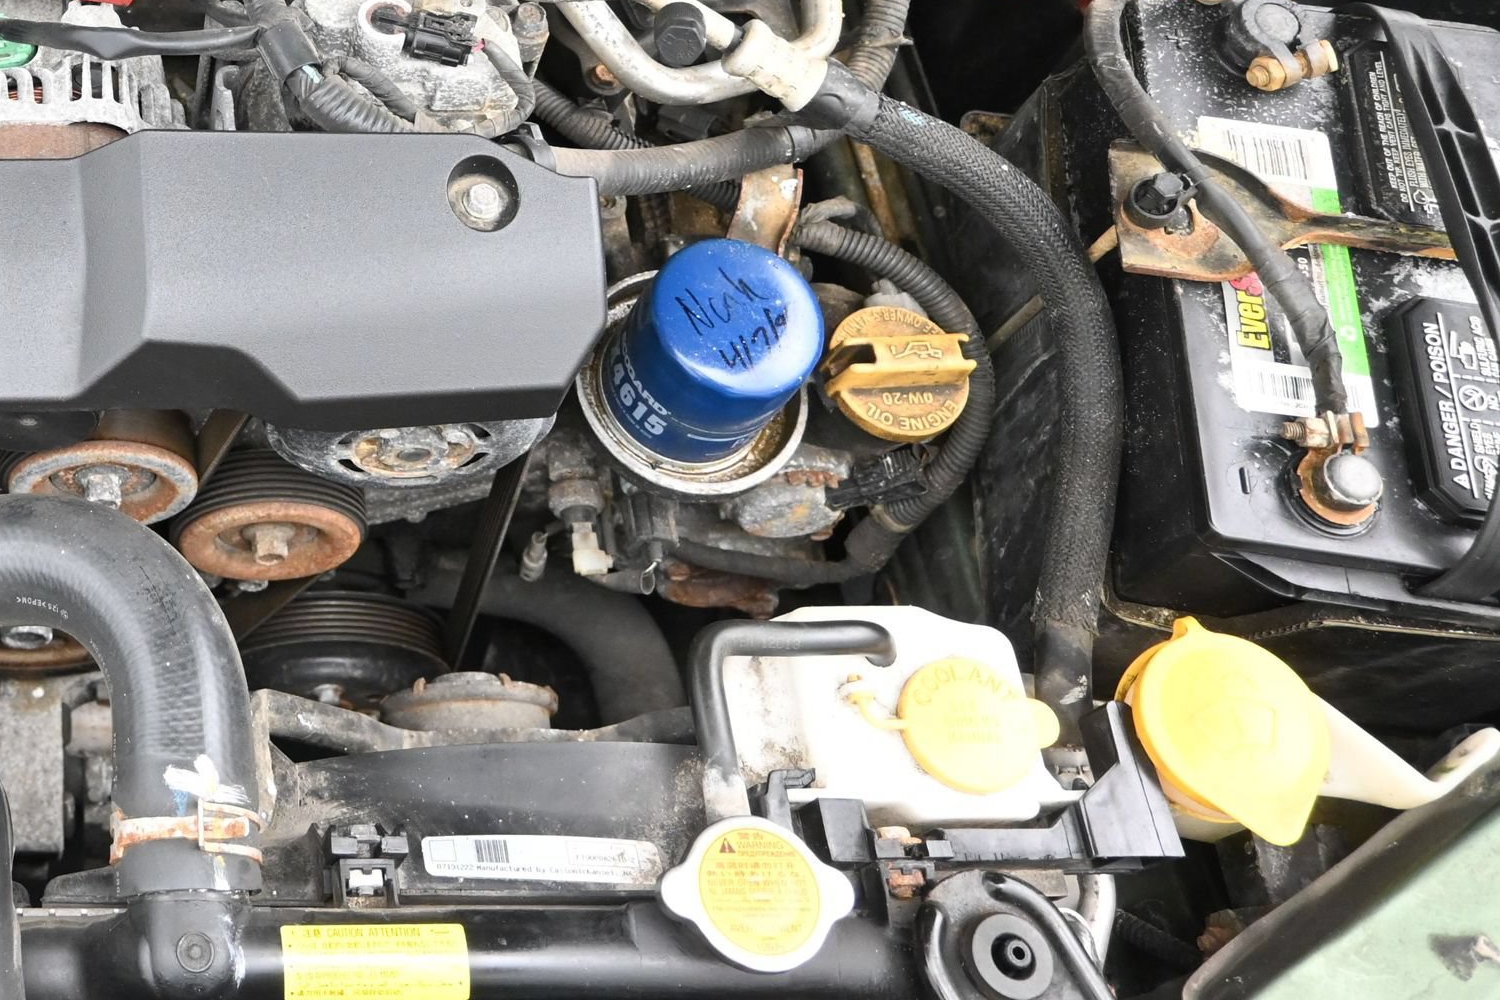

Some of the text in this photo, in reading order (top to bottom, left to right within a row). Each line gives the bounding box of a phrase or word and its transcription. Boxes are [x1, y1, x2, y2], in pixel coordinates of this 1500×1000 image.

[1375, 61, 1384, 77] LEVEL
[1381, 94, 1390, 111] TIGHT
[1385, 113, 1393, 128] CAPS
[1369, 72, 1398, 189] KEEP OUT OF THE REACH OF CHILDREN
[1388, 130, 1397, 146] VENT
[1392, 148, 1400, 163] KEEP
[1405, 151, 1414, 166] EYES
[1407, 168, 1419, 186] FLUSH
[1398, 180, 1407, 191] NOT
[1400, 193, 1408, 202] DO
[1423, 322, 1450, 384] POISON
[1474, 337, 1491, 377] SULFURIC
[882, 391, 933, 405] 0W-20
[867, 400, 958, 431] ENGINE OIL
[1438, 400, 1465, 471] DANGER
[1470, 421, 1484, 454] SHIELD
[913, 663, 1016, 708] COOLANT
[738, 841, 784, 849] WARNING
[476, 864, 532, 873] Manufactured
[536, 866, 546, 874] by
[327, 928, 364, 937] CAUTION
[368, 927, 421, 937] ATTENTION
